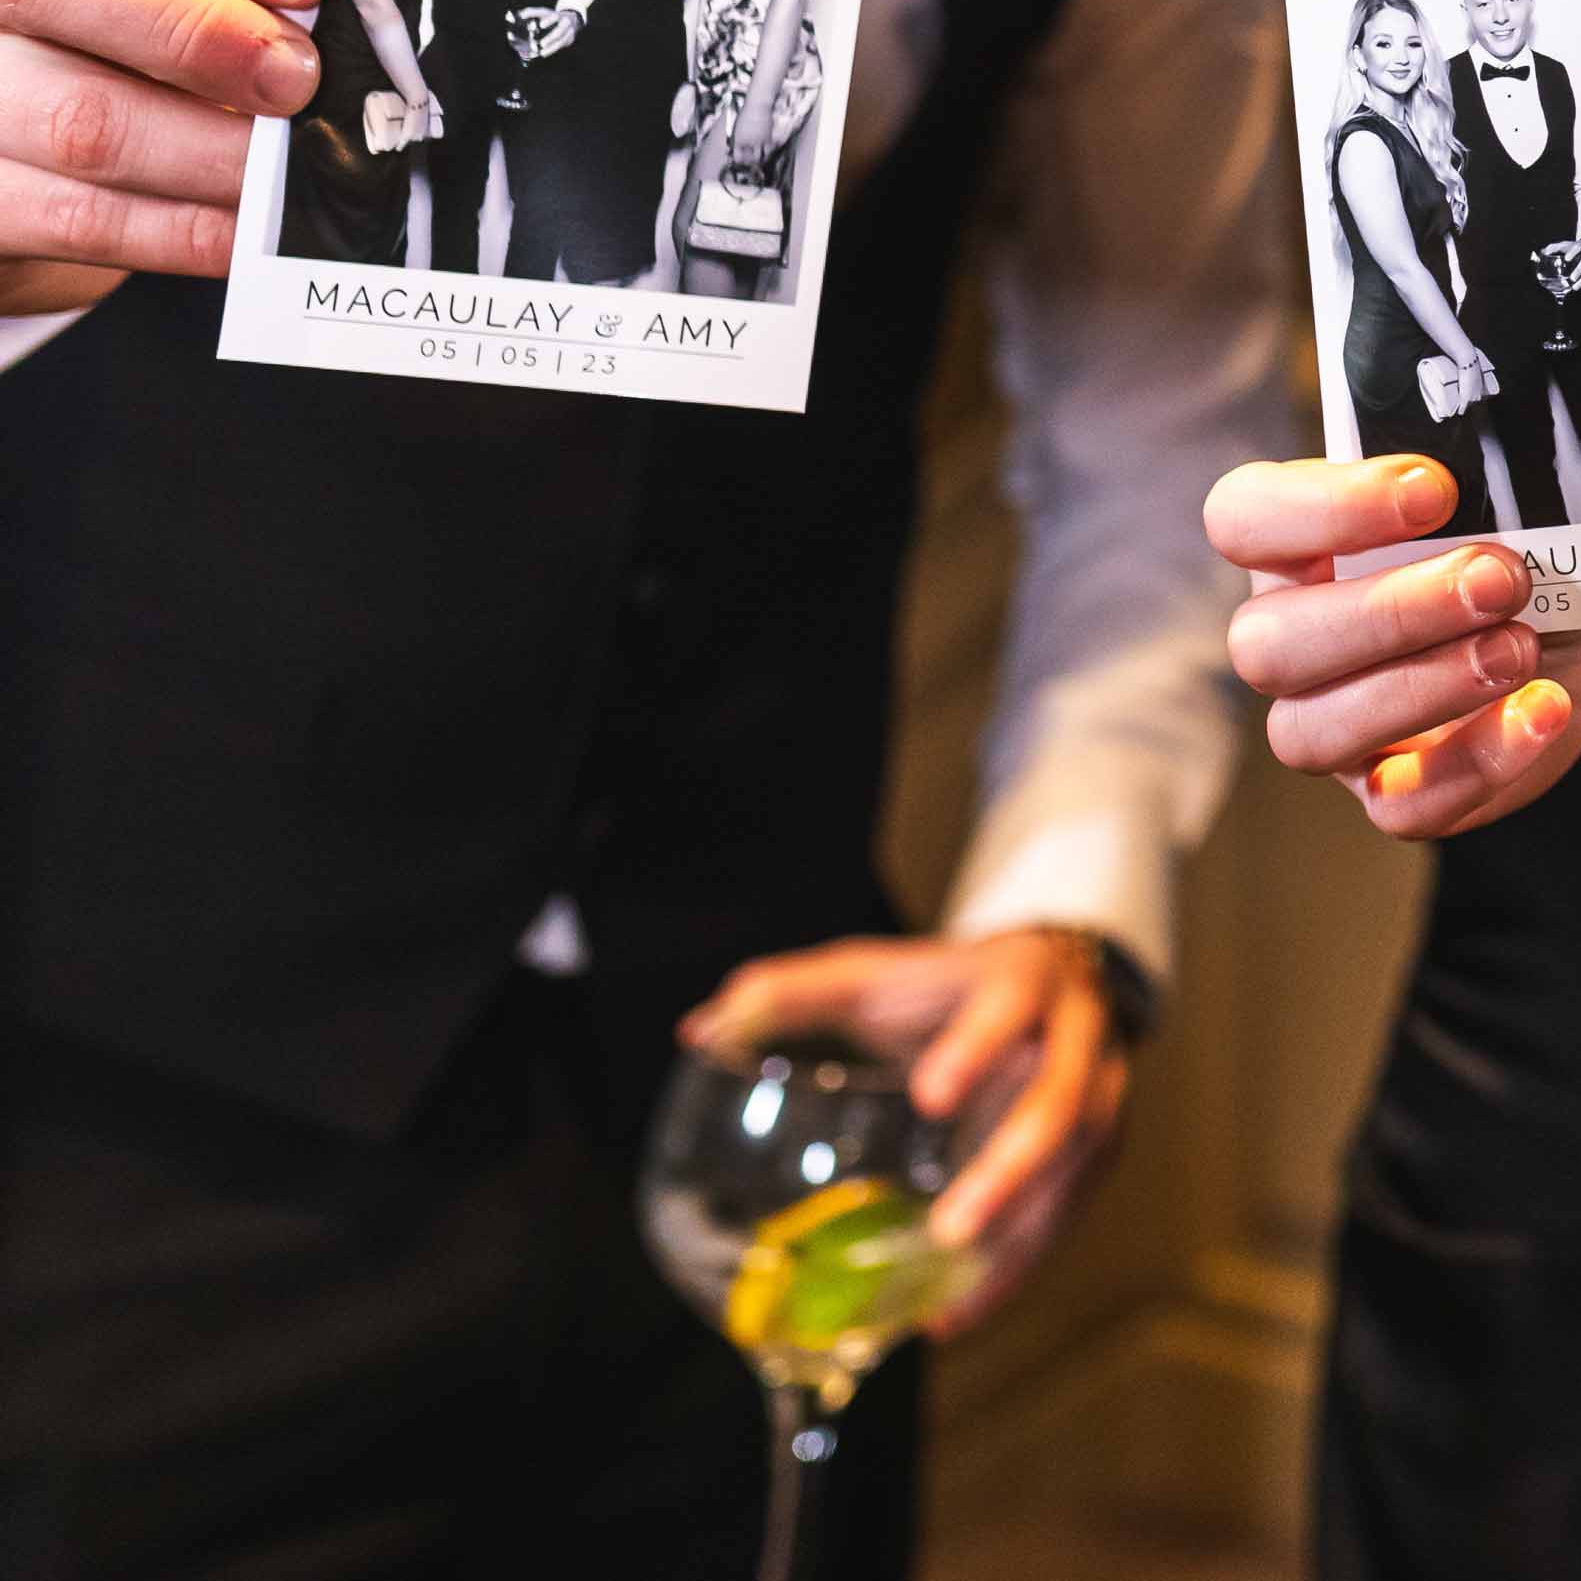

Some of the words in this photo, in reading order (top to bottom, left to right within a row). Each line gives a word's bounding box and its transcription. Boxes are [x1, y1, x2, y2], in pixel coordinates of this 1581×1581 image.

[304, 280, 575, 333] MACAULAY
[594, 313, 623, 338] &
[641, 312, 748, 350] AMY
[419, 339, 458, 361] 05
[501, 345, 538, 368] 05
[581, 353, 618, 376] 23
[1533, 592, 1571, 614] 05
